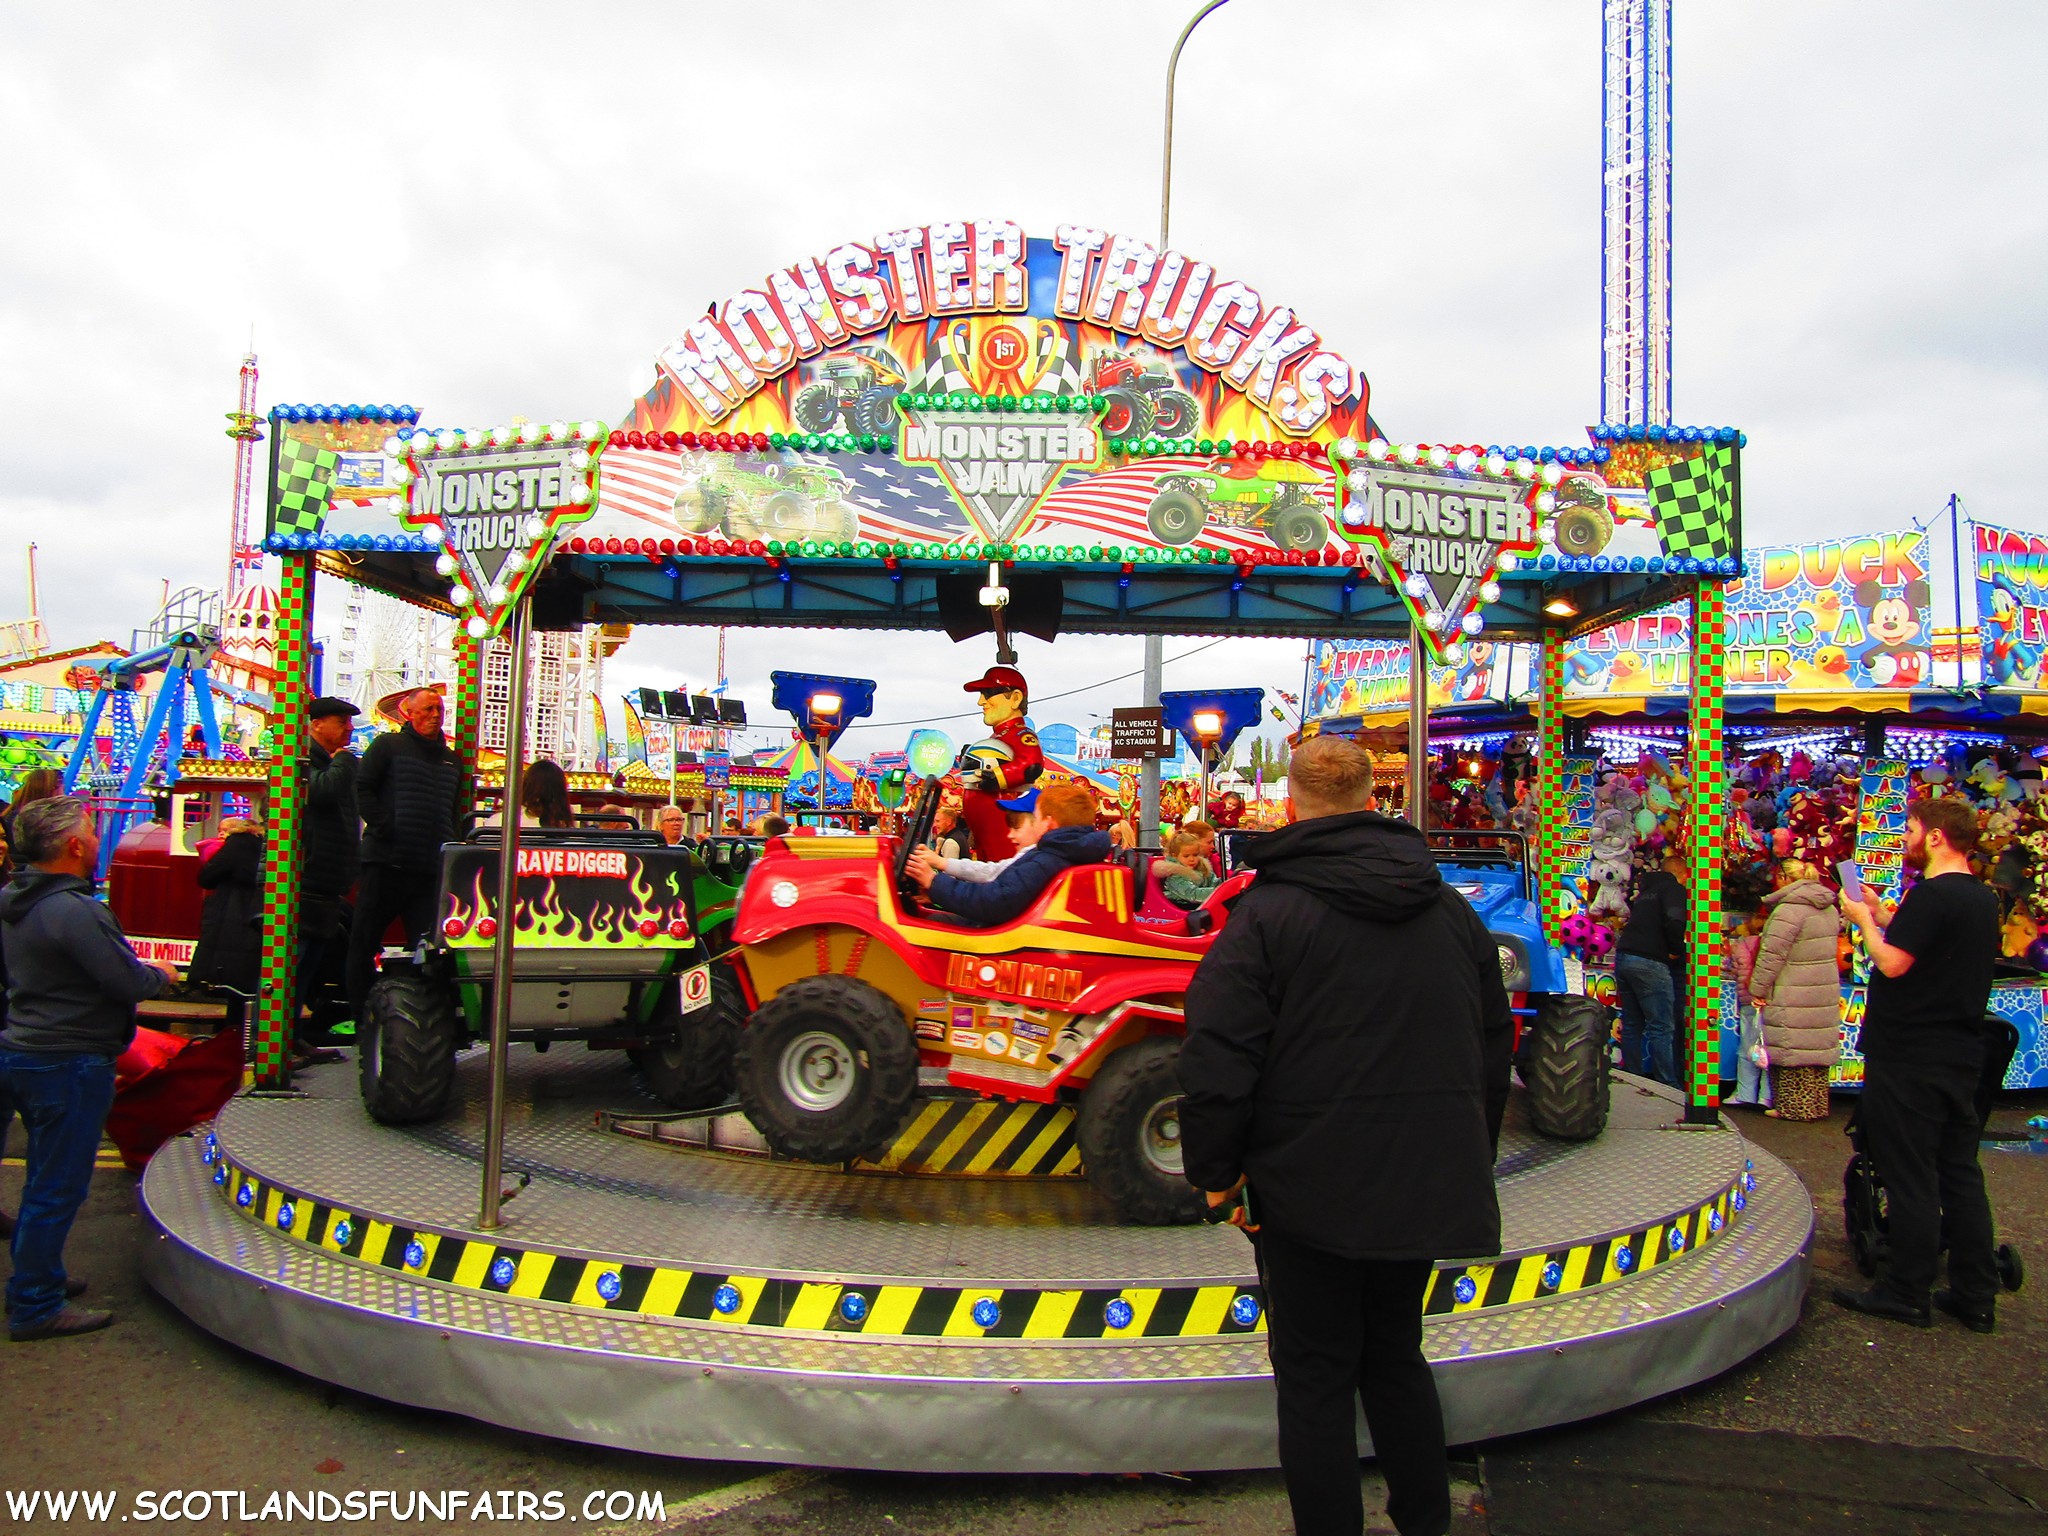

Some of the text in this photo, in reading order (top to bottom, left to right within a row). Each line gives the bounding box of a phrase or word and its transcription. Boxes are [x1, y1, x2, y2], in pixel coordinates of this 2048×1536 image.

[656, 219, 1354, 437] MONSTER TRUCKS
[994, 338, 1015, 360] 1ST
[906, 426, 1098, 462] MONSTER
[956, 461, 1051, 496] JAM
[412, 466, 589, 516] MONSTER
[1352, 484, 1532, 544] MONSTER
[452, 513, 532, 552] TRUCK
[1763, 532, 1925, 590] DUCK
[1588, 607, 1865, 650] EVERONES A
[1650, 650, 1794, 685] WINER
[1360, 676, 1412, 706] WINN
[1114, 720, 1158, 728] ALL VEHICLE
[1115, 729, 1145, 737] TRAFFIC
[648, 729, 686, 753] CRAY
[1114, 738, 1157, 746] KC STADIUM
[1865, 758, 1908, 777] HOOK
[1570, 776, 1580, 791] A
[1878, 778, 1890, 794] A
[1863, 795, 1904, 813] DUCK
[1568, 809, 1578, 824] A
[1877, 814, 1889, 829] A
[1562, 826, 1590, 841] RIZE
[1860, 831, 1903, 848] PRIZE
[1560, 843, 1592, 858] VERY
[1856, 849, 1904, 867] EVERY
[517, 850, 628, 875] RAVE DIGGER
[1863, 867, 1895, 885] TIME
[153, 942, 193, 962] WHILE
[946, 952, 1083, 1003] IRON MAN
